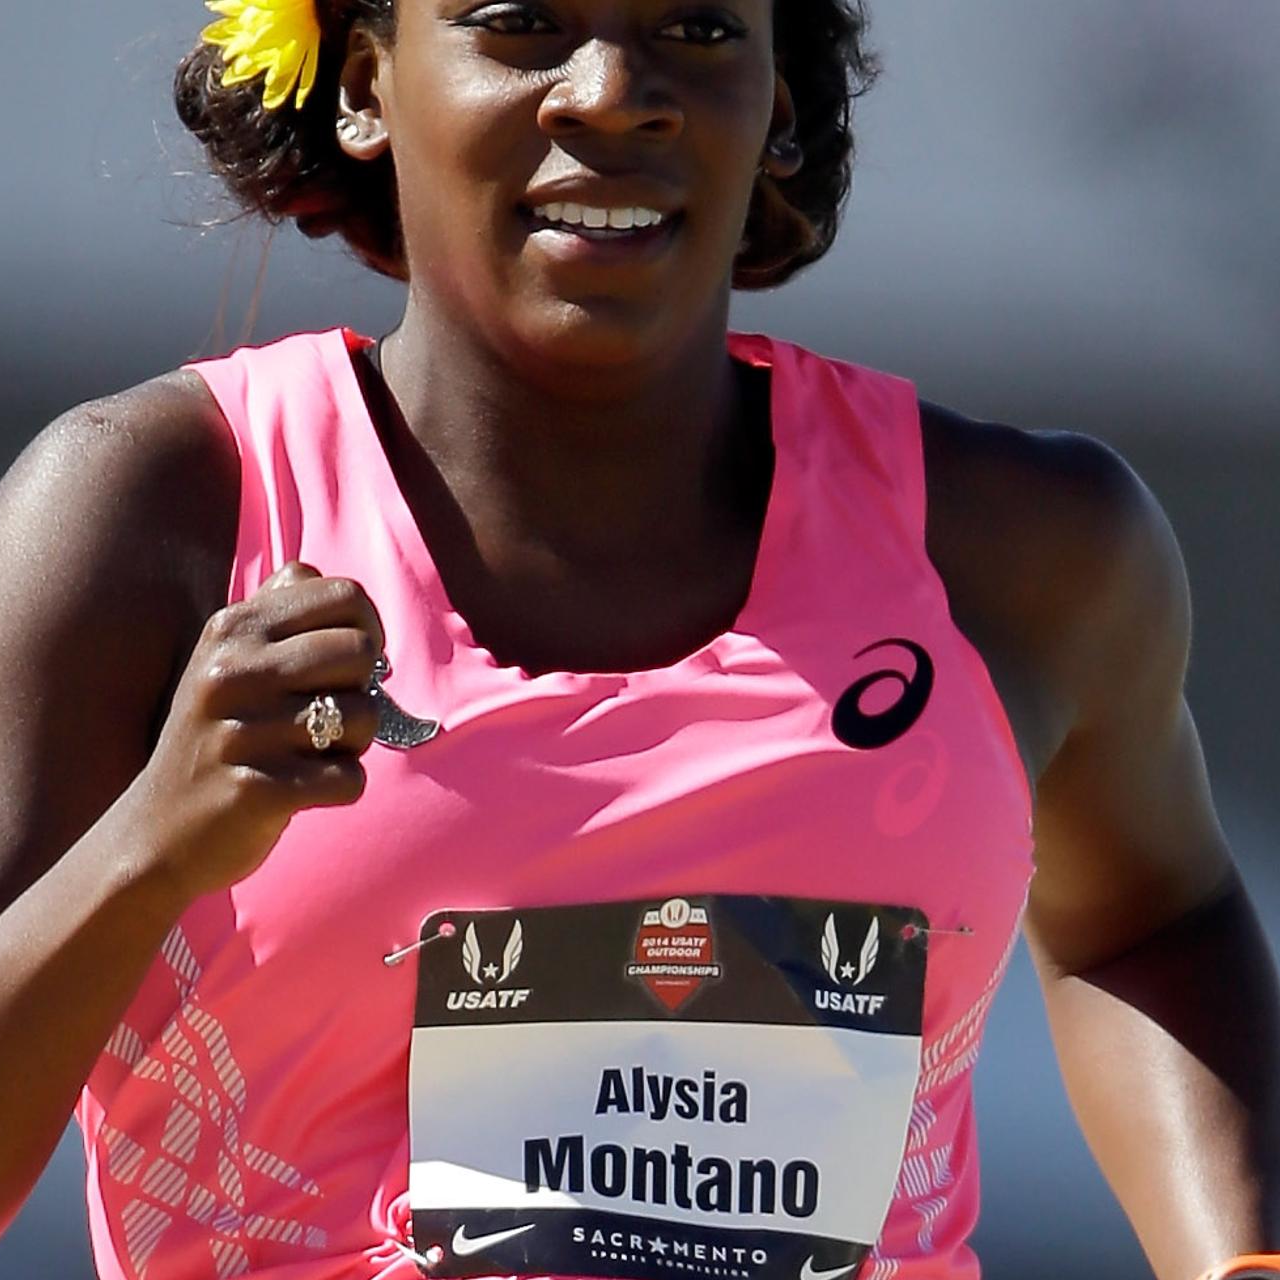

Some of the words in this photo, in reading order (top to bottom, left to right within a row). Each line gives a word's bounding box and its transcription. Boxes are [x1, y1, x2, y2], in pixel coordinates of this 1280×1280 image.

[642, 937, 669, 947] 2014
[671, 937, 707, 947] USATF
[647, 948, 700, 958] OUTDOOR
[628, 964, 719, 976] CHAMPIONSHIPS
[446, 989, 530, 1010] USATF
[815, 989, 885, 1015] USATF
[595, 1066, 749, 1123] Alysia
[523, 1134, 820, 1218] Montano
